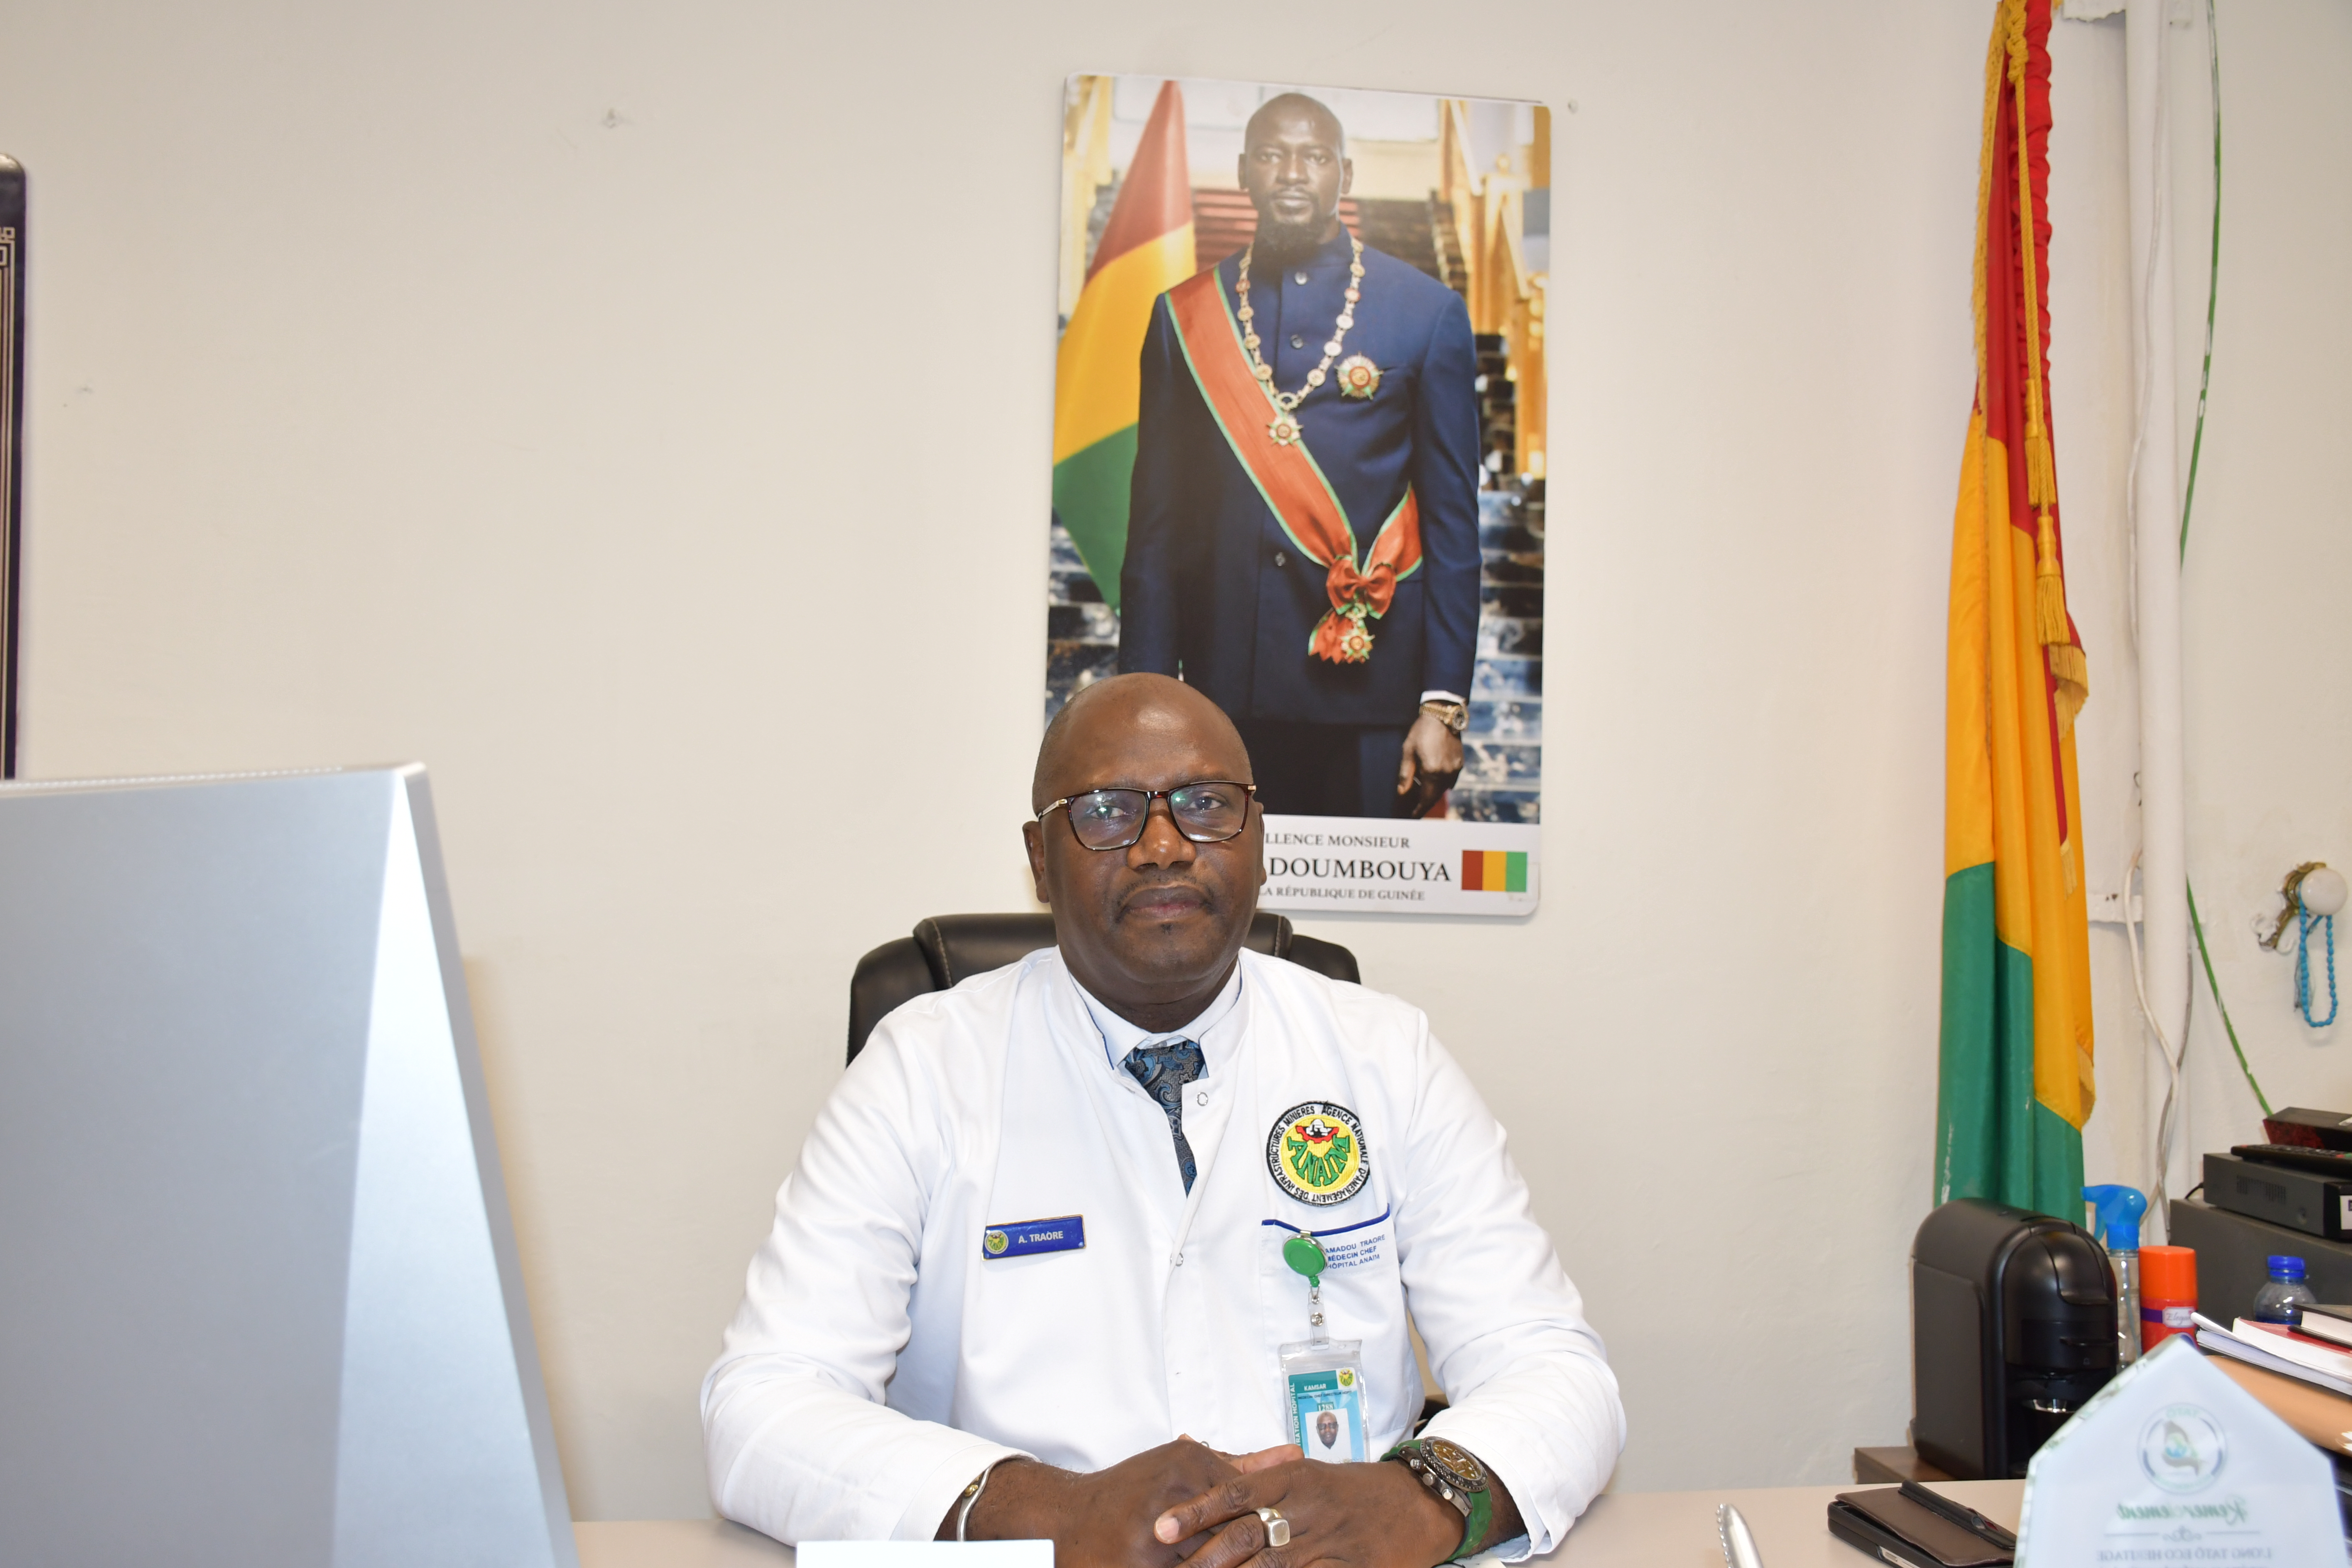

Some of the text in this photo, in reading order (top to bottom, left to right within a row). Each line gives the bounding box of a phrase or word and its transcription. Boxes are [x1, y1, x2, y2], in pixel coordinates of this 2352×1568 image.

[1265, 833, 1410, 849] LLENCE MONSIEUR
[1269, 856, 1451, 882] DOUMBOUYA
[1276, 885, 1354, 901] RÉPUBLIQUE
[1358, 890, 1375, 899] DE
[1377, 887, 1425, 901] GUINÉE
[1283, 1106, 1315, 1126] MINIERES
[1322, 1105, 1353, 1125] AGENCE
[1350, 1122, 1369, 1165] NATIONALE
[1294, 1187, 1309, 1200] DES
[1018, 1231, 1064, 1244] A. TRAORE
[1360, 1234, 1385, 1247] TRAORE
[1360, 1246, 1377, 1255] CHEF
[1359, 1254, 1380, 1264] ANAIM
[1290, 1383, 1298, 1415] HOPITAL
